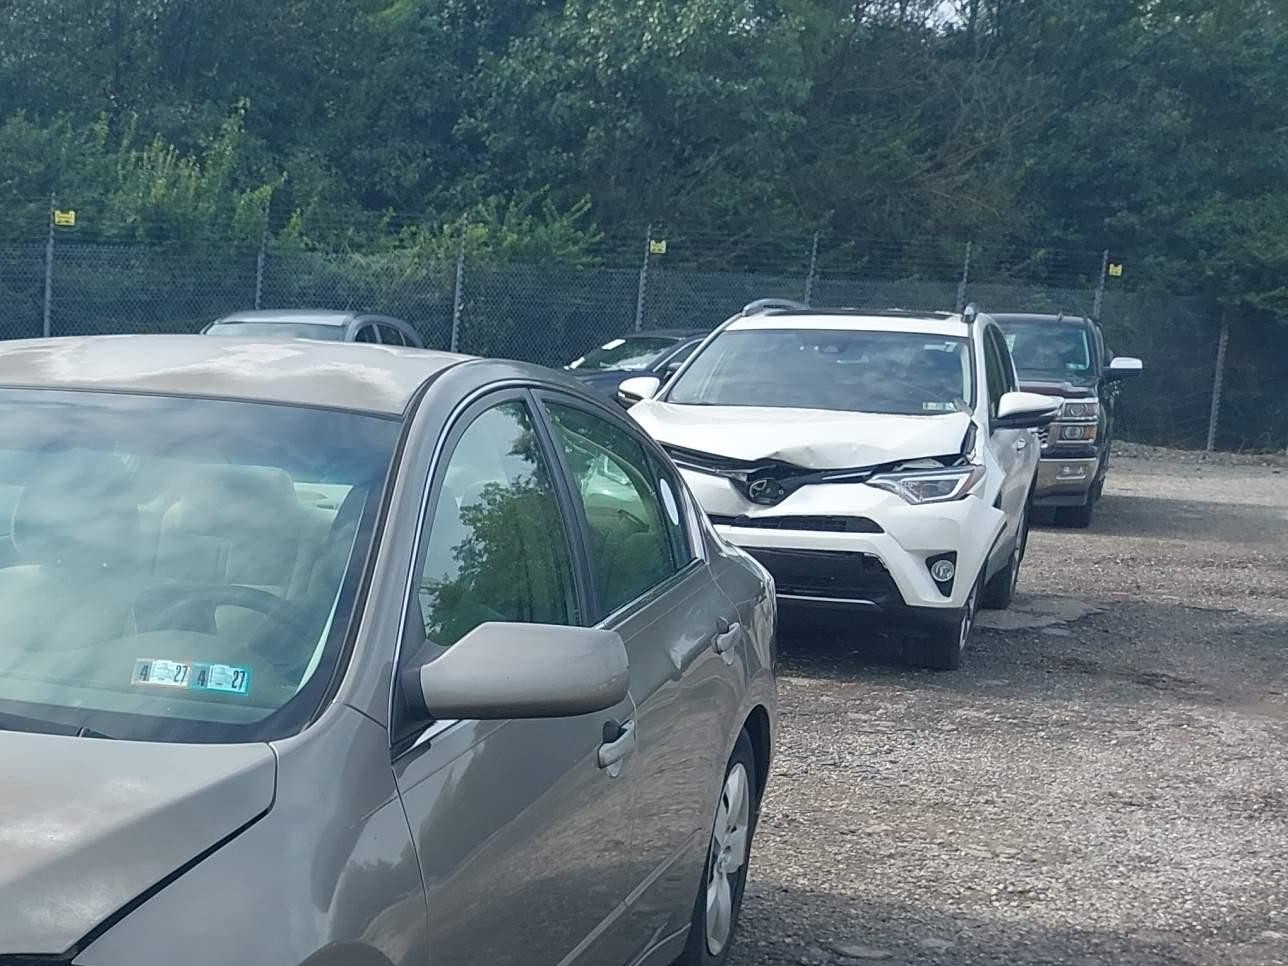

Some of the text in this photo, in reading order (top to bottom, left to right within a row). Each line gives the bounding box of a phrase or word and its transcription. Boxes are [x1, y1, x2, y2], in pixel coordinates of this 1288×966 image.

[139, 664, 150, 683] 4
[174, 664, 189, 685] 27
[197, 669, 207, 688] 4
[231, 670, 246, 691] 27
